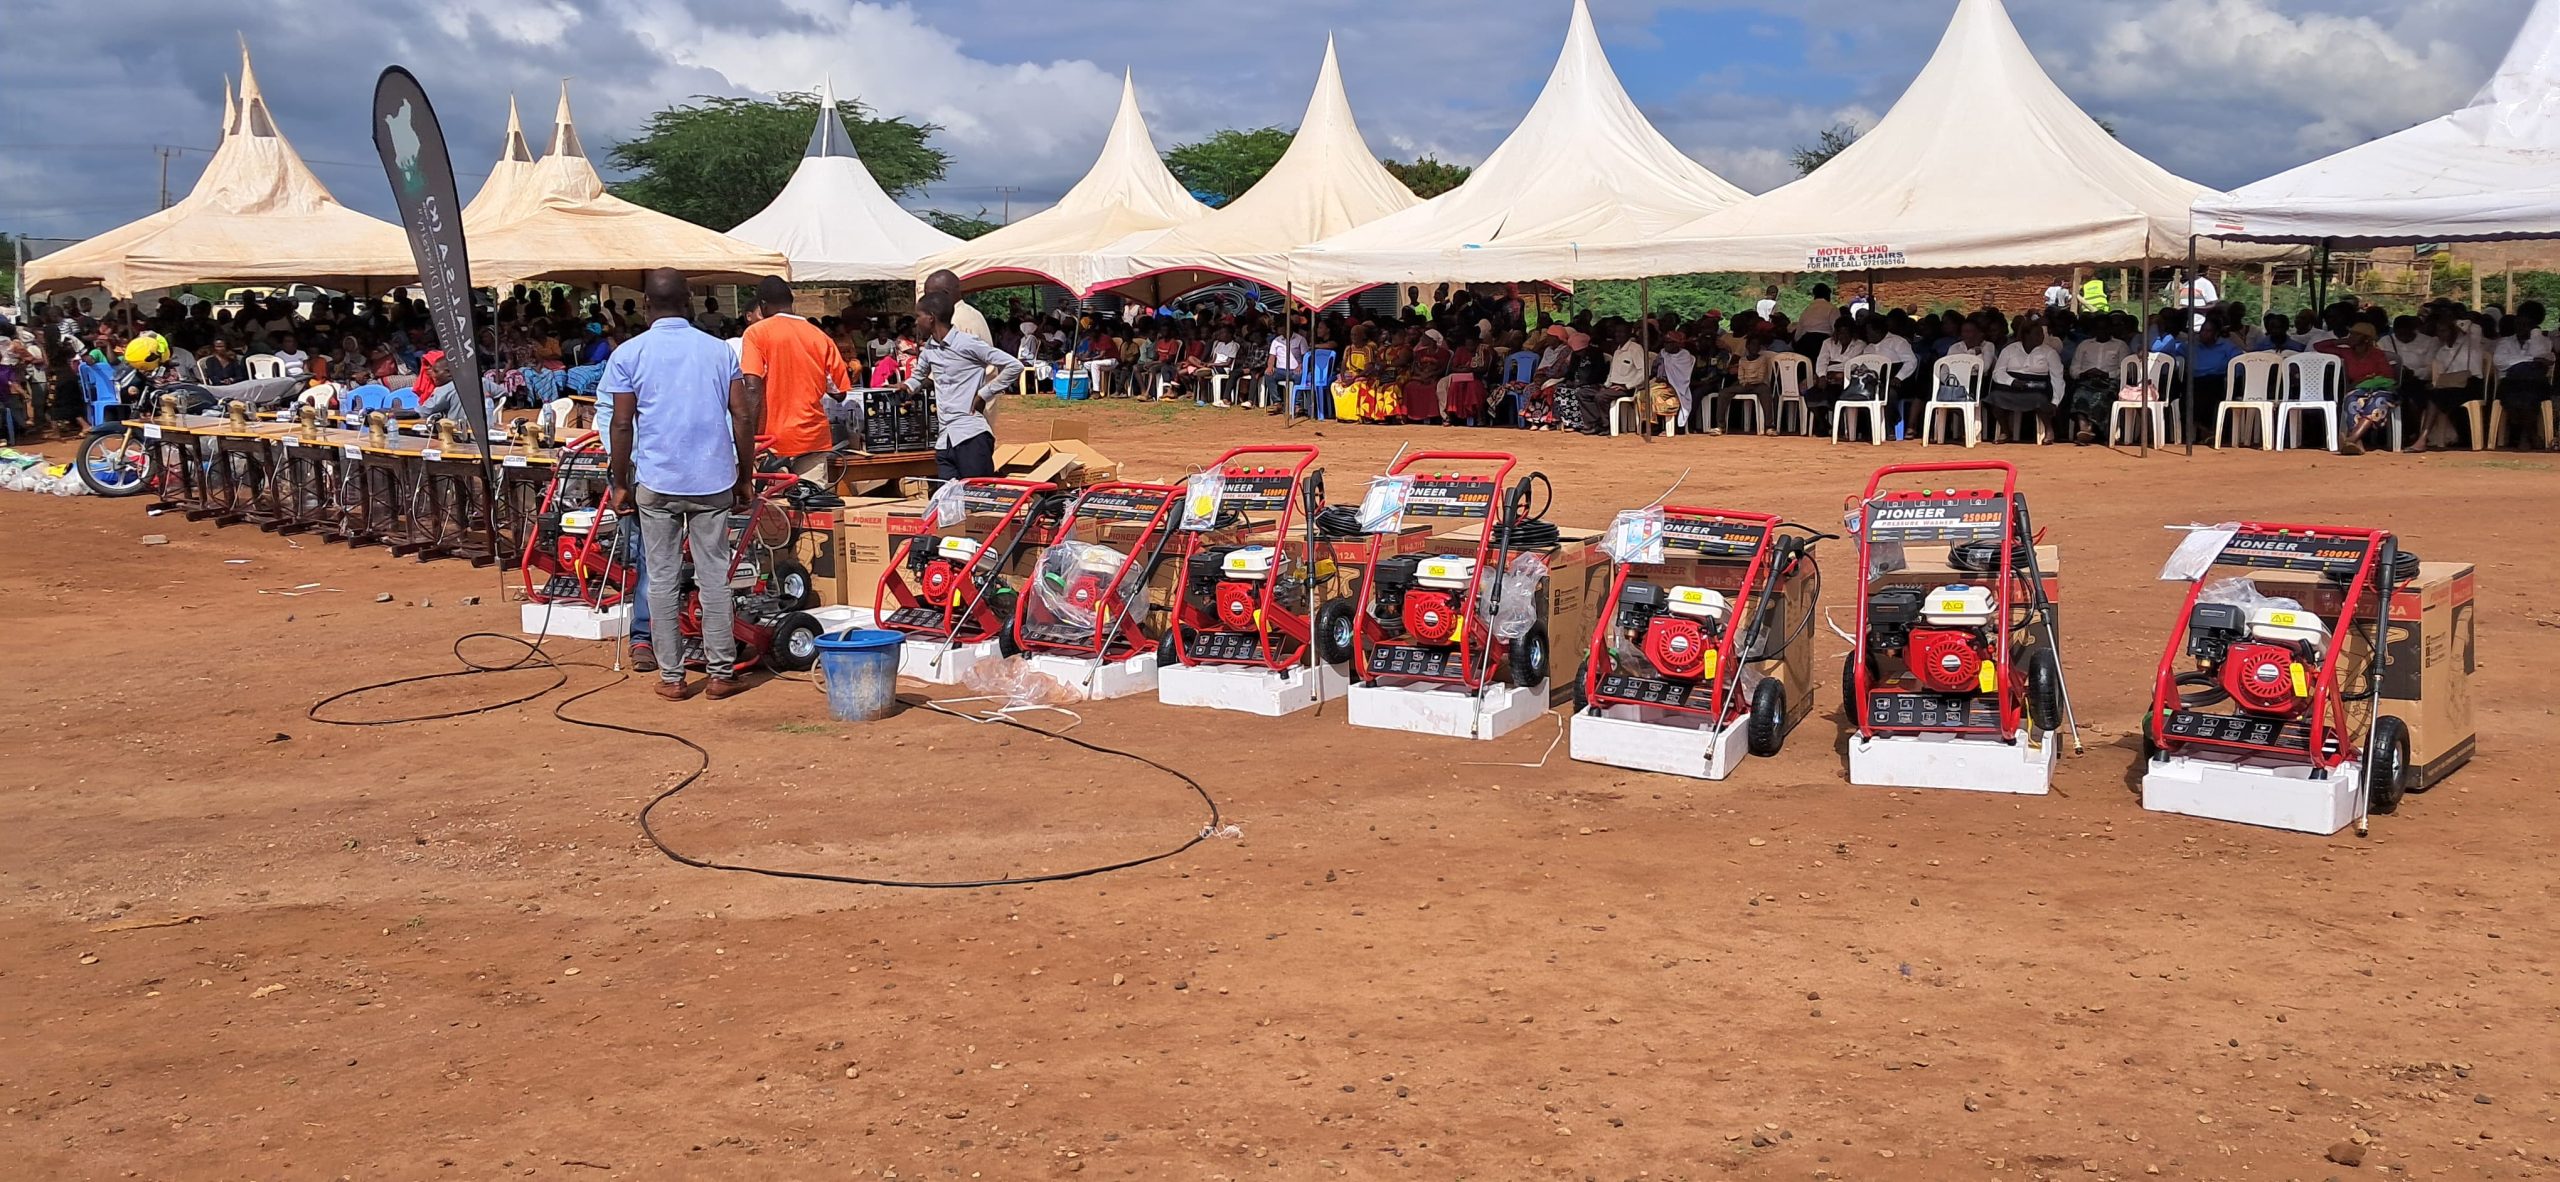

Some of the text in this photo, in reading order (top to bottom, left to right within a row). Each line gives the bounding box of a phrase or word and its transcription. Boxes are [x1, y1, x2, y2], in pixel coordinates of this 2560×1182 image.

[1817, 245, 1888, 256] MOTHERLAND
[1808, 255, 1845, 263] TENTS
[1860, 252, 1904, 260] CHAIRS
[1408, 488, 1447, 497] ONEER
[1087, 497, 1128, 505] PIONEER
[1459, 494, 1490, 502] 2500PSI
[1877, 508, 1945, 519] PIONEER
[1962, 512, 2002, 522] 2500PSI
[1664, 524, 1710, 534] ONEER
[1722, 533, 1760, 543] 2500PSI
[2230, 539, 2298, 551] IONEER
[2315, 549, 2361, 559] 2500PSI
[1632, 564, 1686, 575] PIONEER
